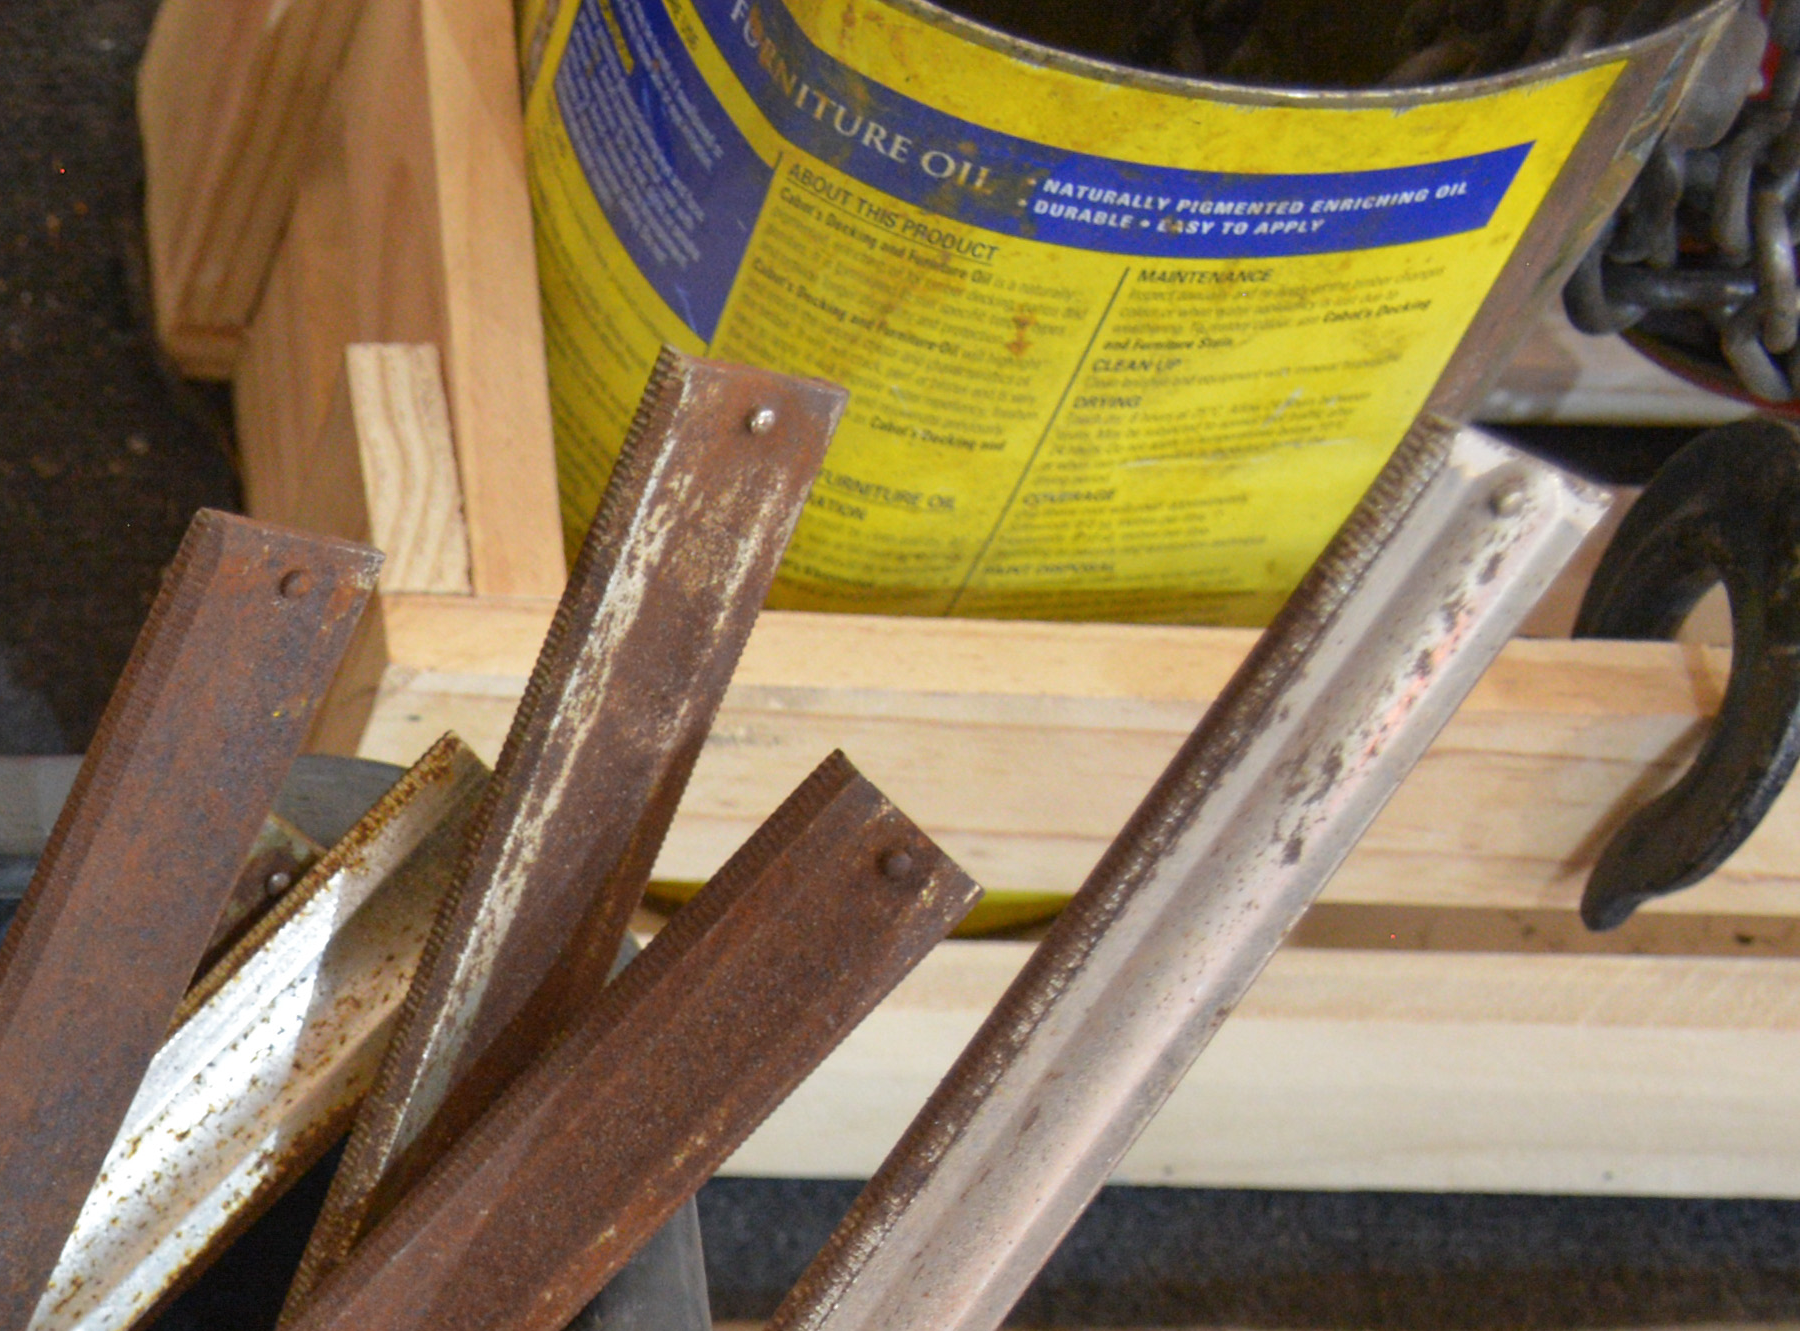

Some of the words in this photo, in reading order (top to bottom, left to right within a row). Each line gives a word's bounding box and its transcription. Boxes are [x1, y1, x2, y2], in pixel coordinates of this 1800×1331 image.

[920, 150, 993, 195] OIL
[788, 163, 853, 206] ABOUT
[856, 197, 897, 228] THIS
[901, 217, 1000, 262] PRODUCT
[1042, 178, 1171, 211] NATURALLY
[1175, 198, 1305, 216] PIGMENTED
[1309, 186, 1430, 215] ENRICHING
[1434, 180, 1468, 200] OIL
[1033, 199, 1135, 230] DURABLE
[1156, 217, 1216, 236] EASY
[1221, 221, 1250, 236] TO
[1252, 218, 1326, 236] APPLY
[1137, 268, 1274, 284] MAINTENANCE
